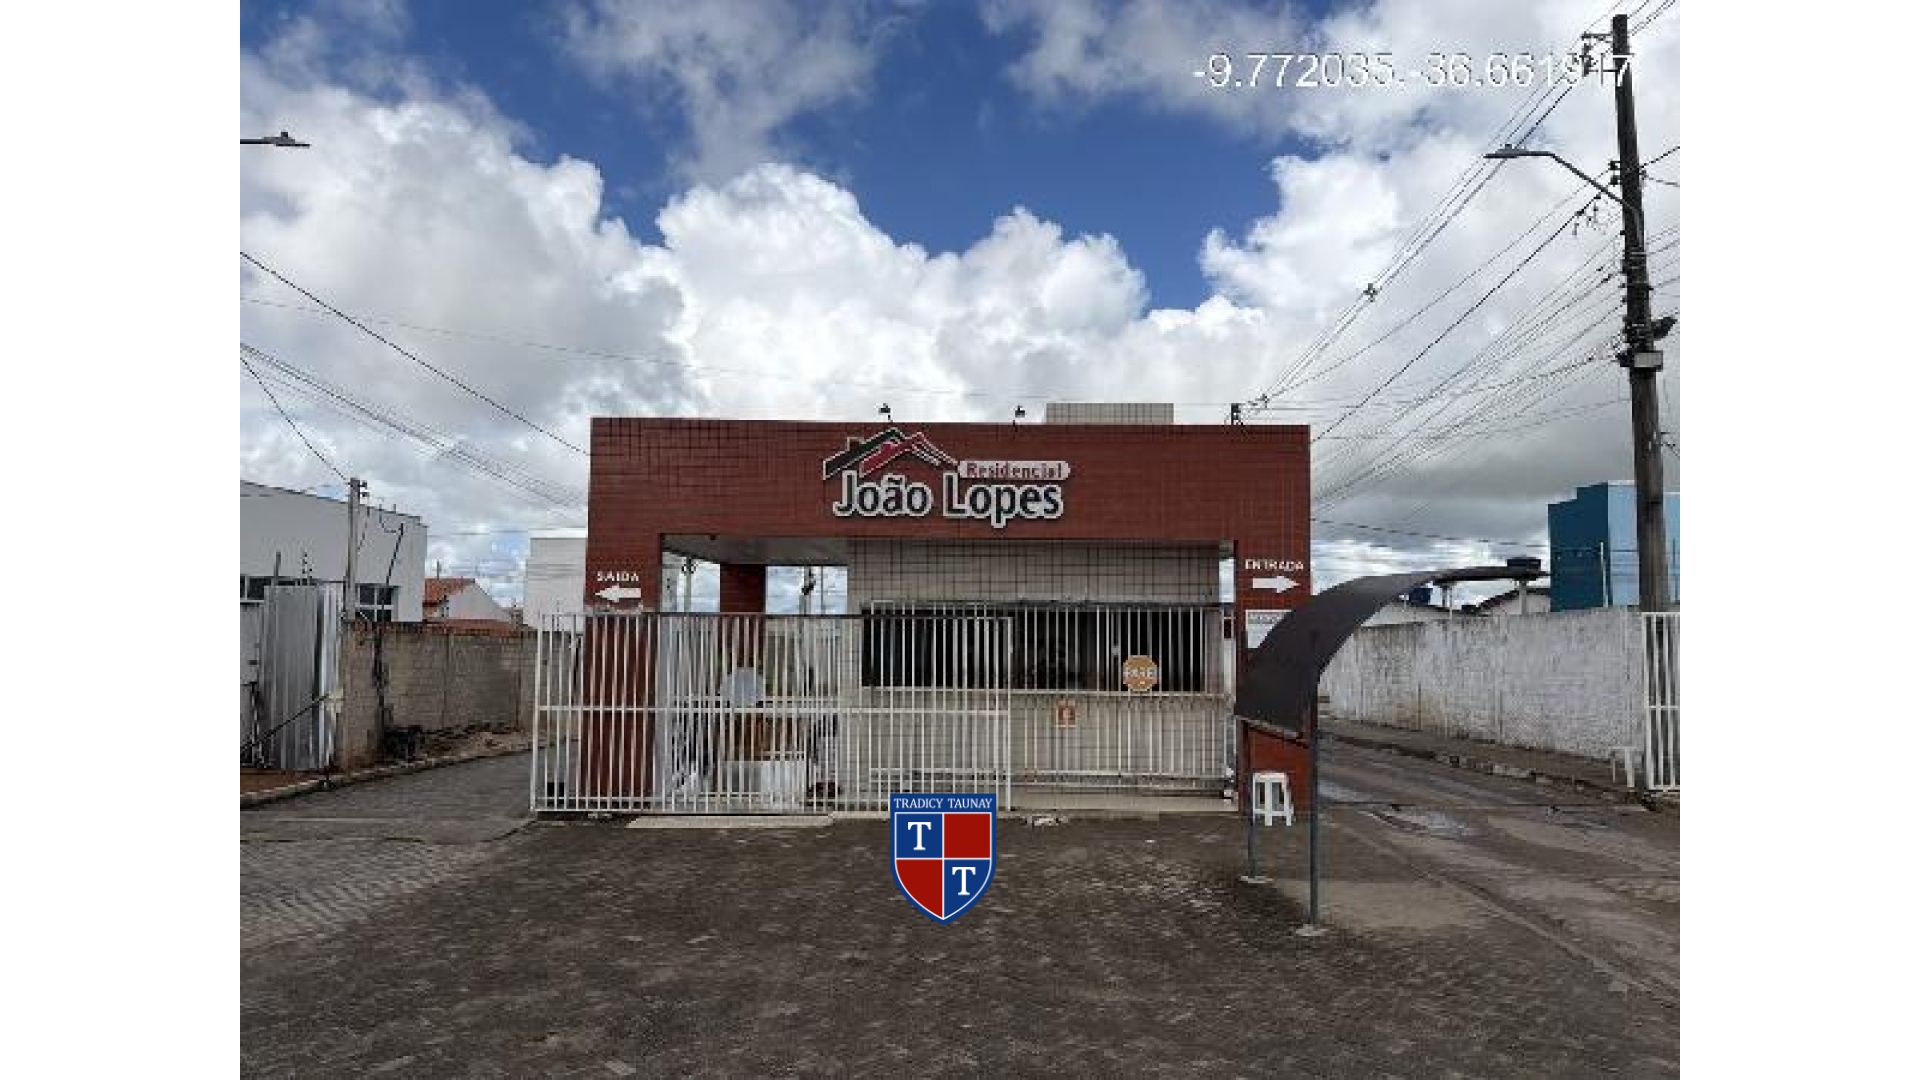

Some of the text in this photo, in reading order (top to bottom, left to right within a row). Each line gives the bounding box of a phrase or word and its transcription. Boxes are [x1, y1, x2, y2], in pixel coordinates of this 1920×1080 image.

[964, 461, 1064, 478] Residencial
[833, 470, 1063, 528] João Lopes
[1245, 558, 1304, 572] ENTRADA
